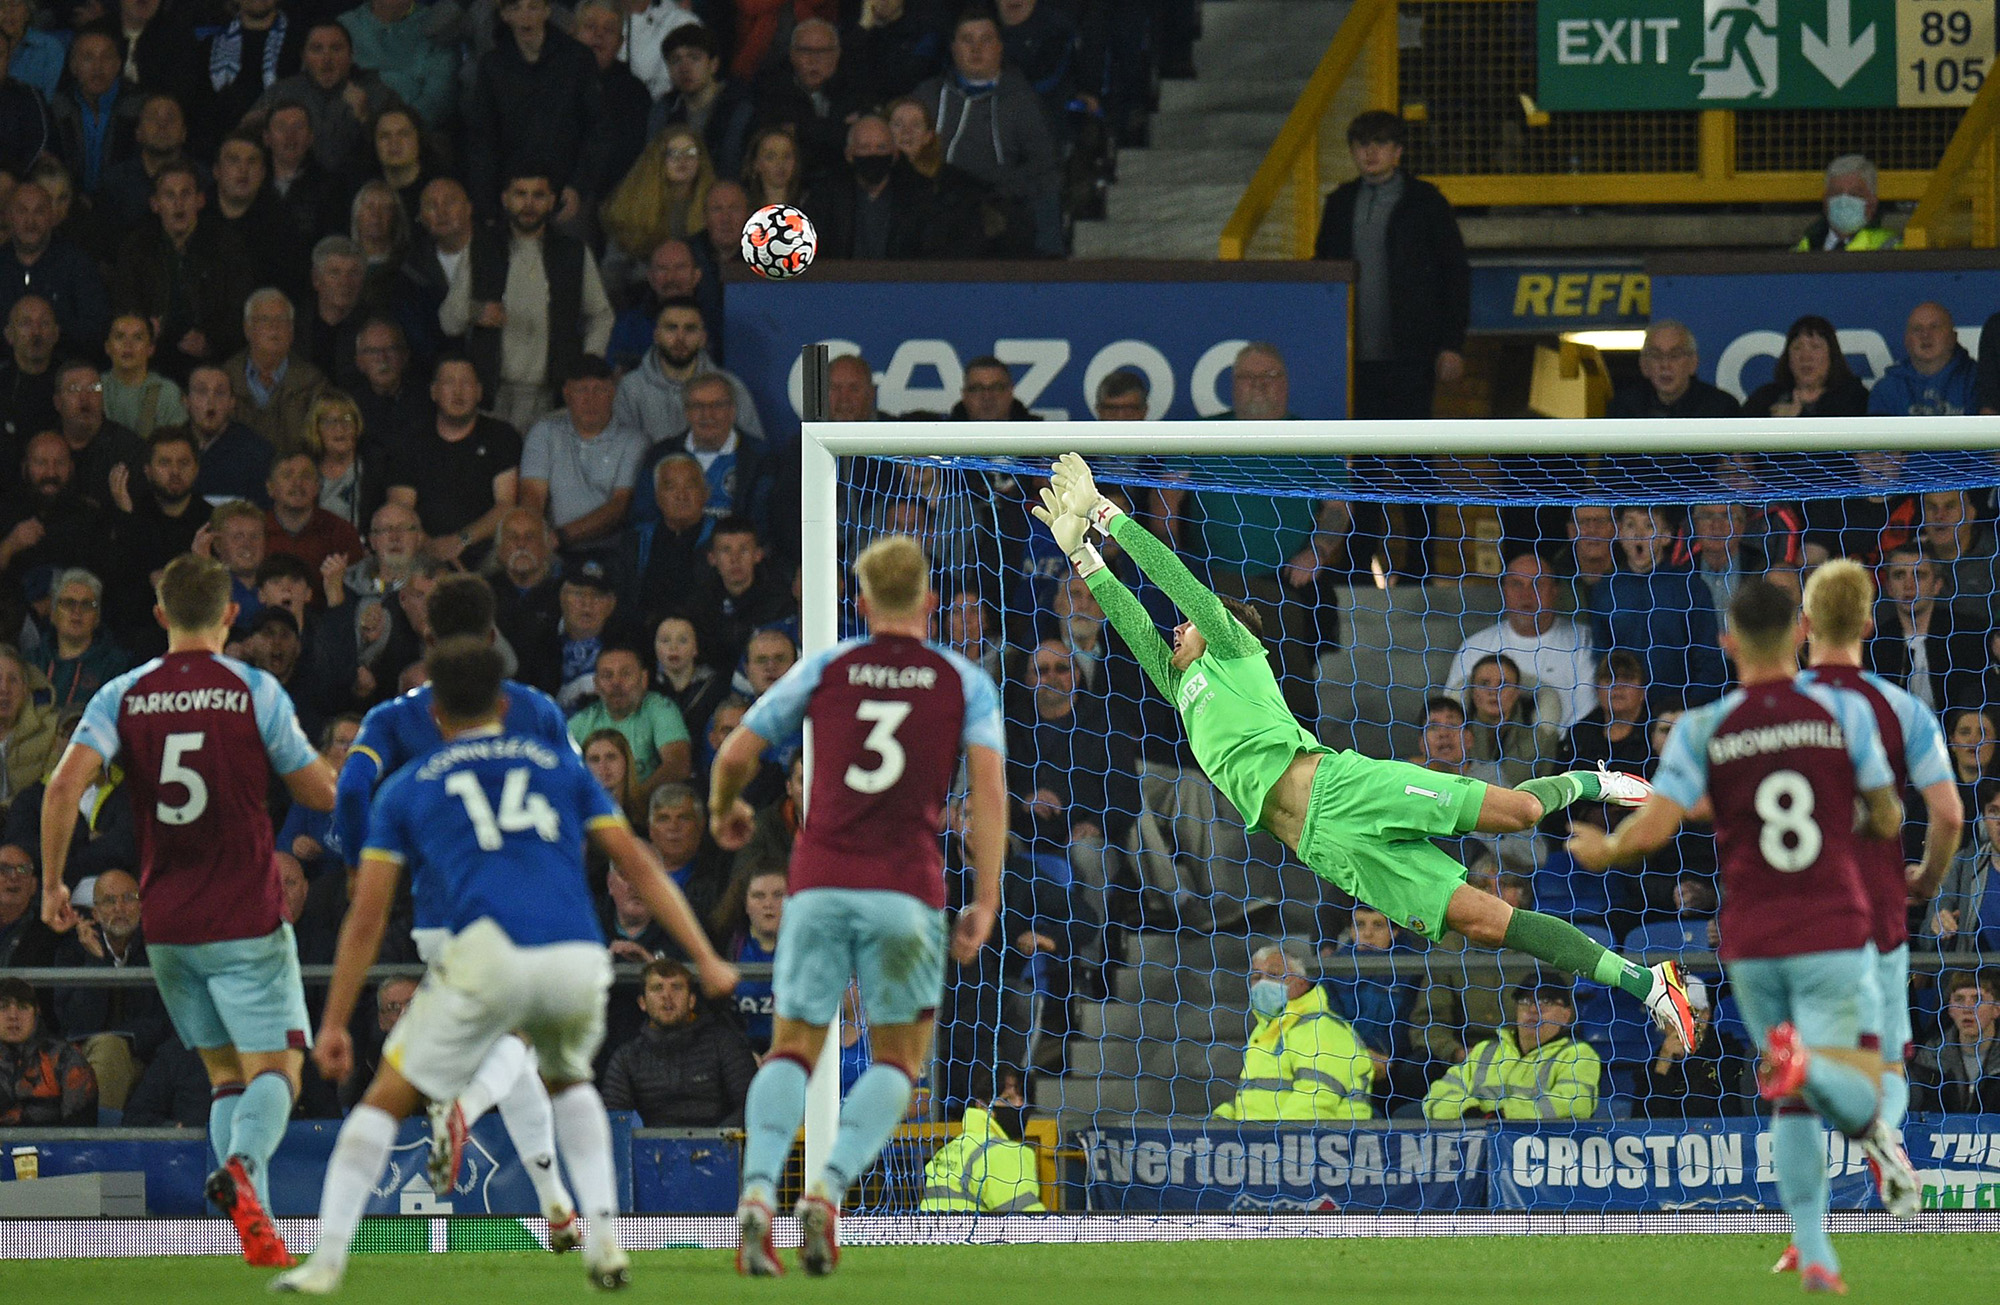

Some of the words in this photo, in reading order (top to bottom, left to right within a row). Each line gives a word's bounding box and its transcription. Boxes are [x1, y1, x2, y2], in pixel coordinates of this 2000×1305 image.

[1557, 18, 1680, 65] EXIT
[1921, 10, 1971, 46] 89
[1910, 56, 1984, 94] 105
[1512, 272, 1652, 317] REFR
[847, 663, 938, 690] TAYLOR
[124, 687, 249, 716] TARKOWSKI
[843, 699, 914, 794] 3
[156, 731, 208, 825] 5
[1404, 785, 1439, 800] 1
[444, 766, 561, 852] 14
[1754, 769, 1823, 873] 8
[1512, 1132, 1744, 1190] CROSTON
